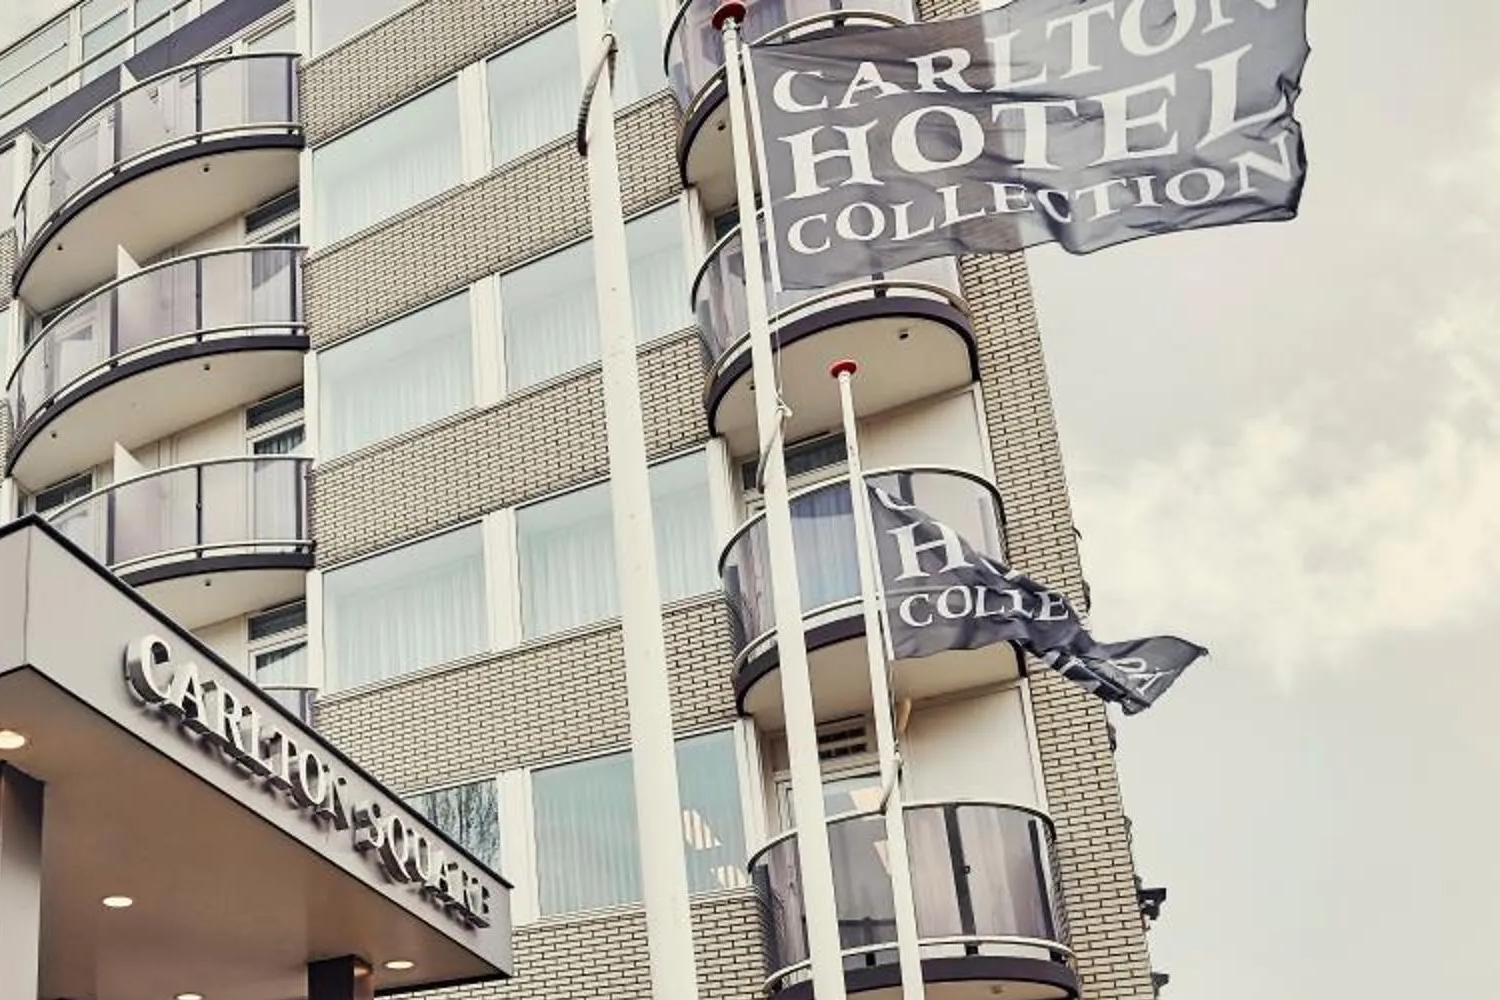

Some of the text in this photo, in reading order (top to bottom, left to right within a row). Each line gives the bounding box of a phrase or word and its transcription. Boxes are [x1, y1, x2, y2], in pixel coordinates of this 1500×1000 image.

[778, 43, 1290, 200] HOTEL
[787, 134, 1294, 255] COLLECTION
[126, 634, 492, 928] CARLTON SQUARE
